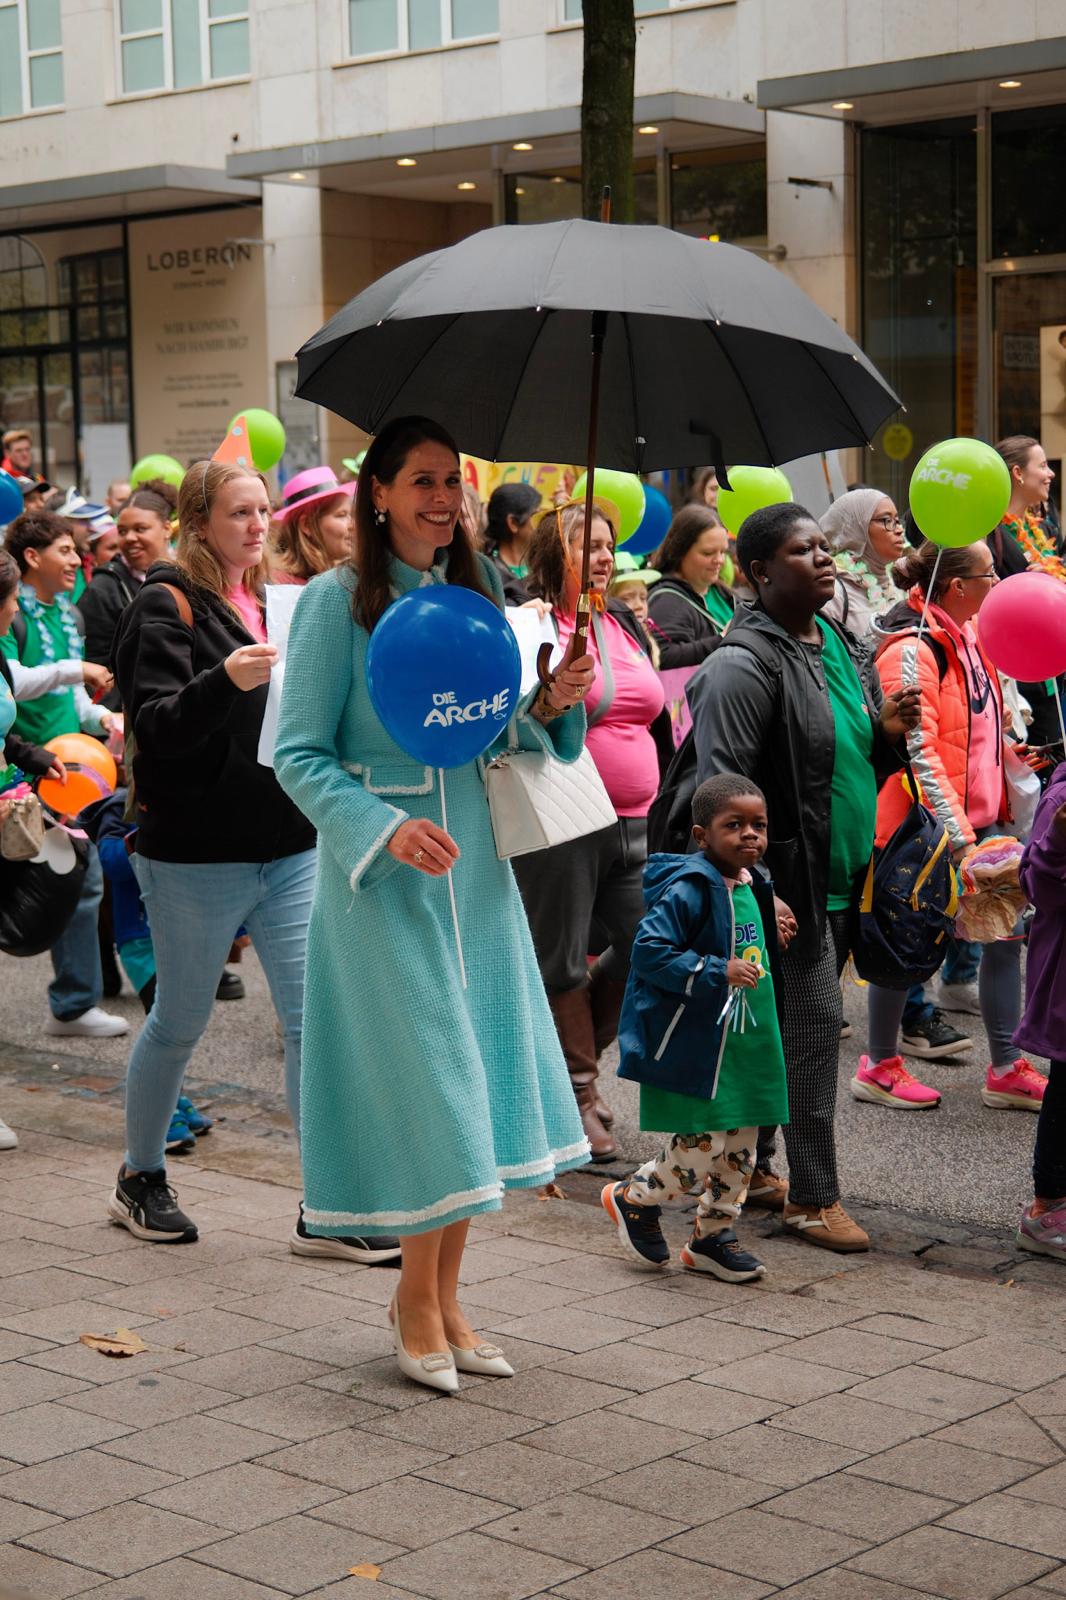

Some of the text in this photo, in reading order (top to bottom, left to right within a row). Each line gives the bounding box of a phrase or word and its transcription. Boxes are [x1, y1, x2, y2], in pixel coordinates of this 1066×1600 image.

[147, 243, 251, 270] LOBERON
[917, 467, 972, 490] ARCHE
[423, 688, 510, 727] ARCHE
[432, 691, 457, 706] DIE
[735, 922, 758, 944] DIE
